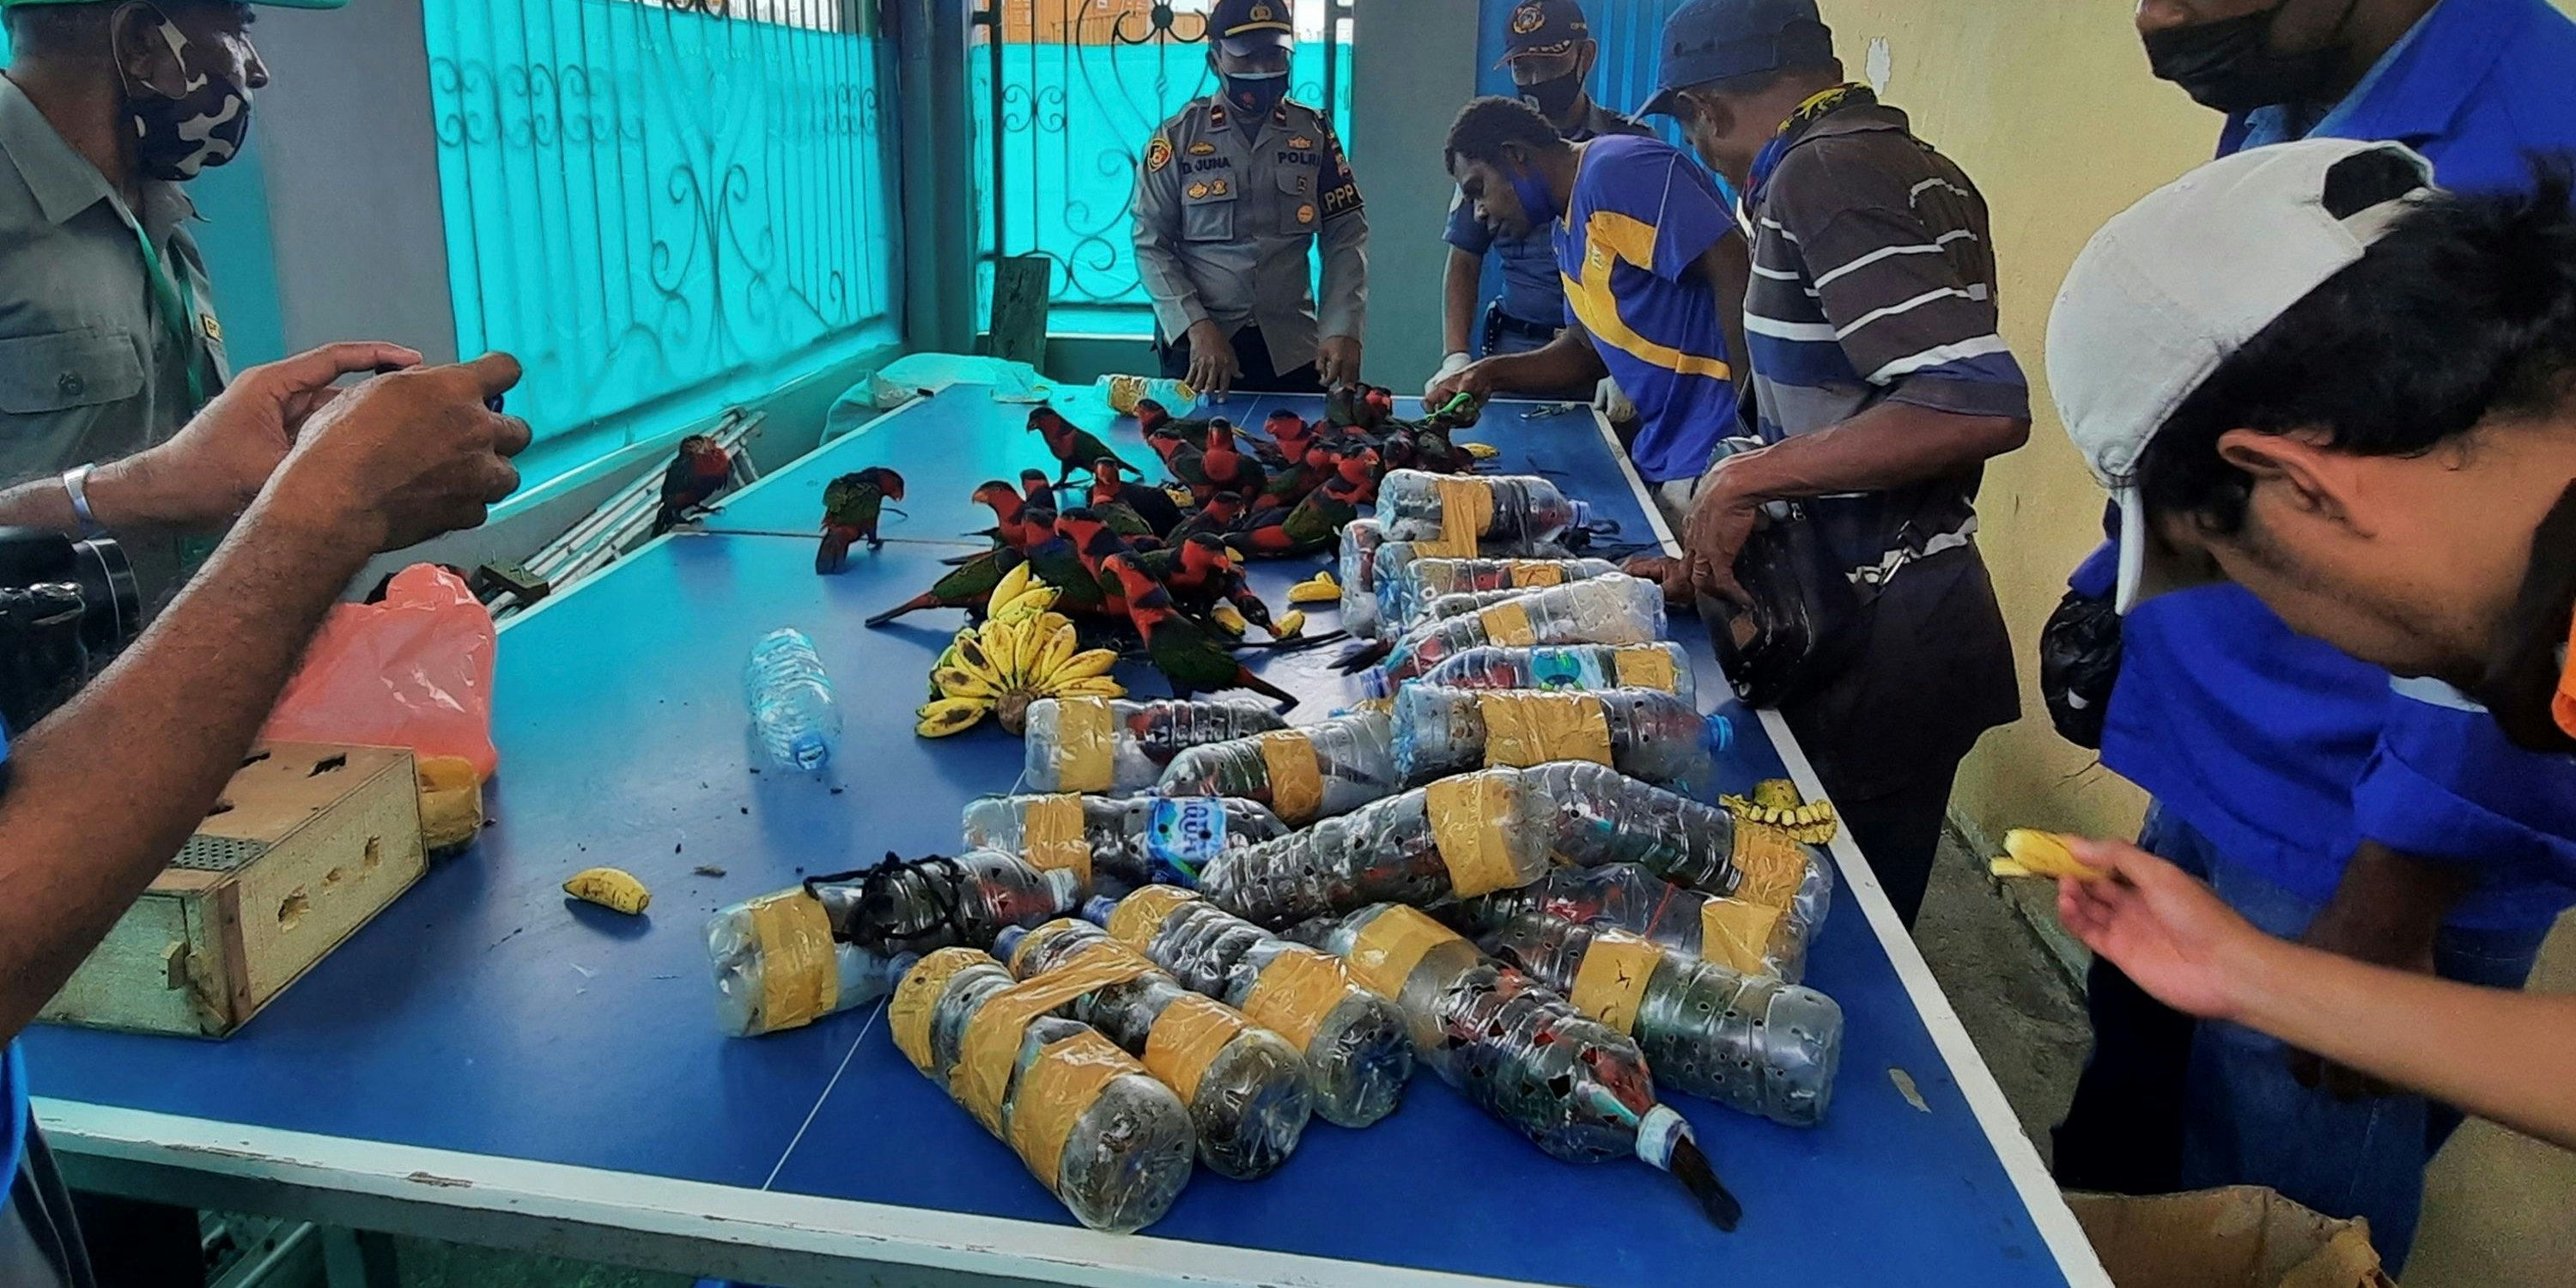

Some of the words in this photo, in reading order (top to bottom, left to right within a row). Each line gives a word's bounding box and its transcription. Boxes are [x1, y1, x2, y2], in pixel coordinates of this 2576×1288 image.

[1194, 156, 1231, 172] JUNA
[1277, 151, 1321, 167] POLRI
[1324, 184, 1355, 212] PPP
